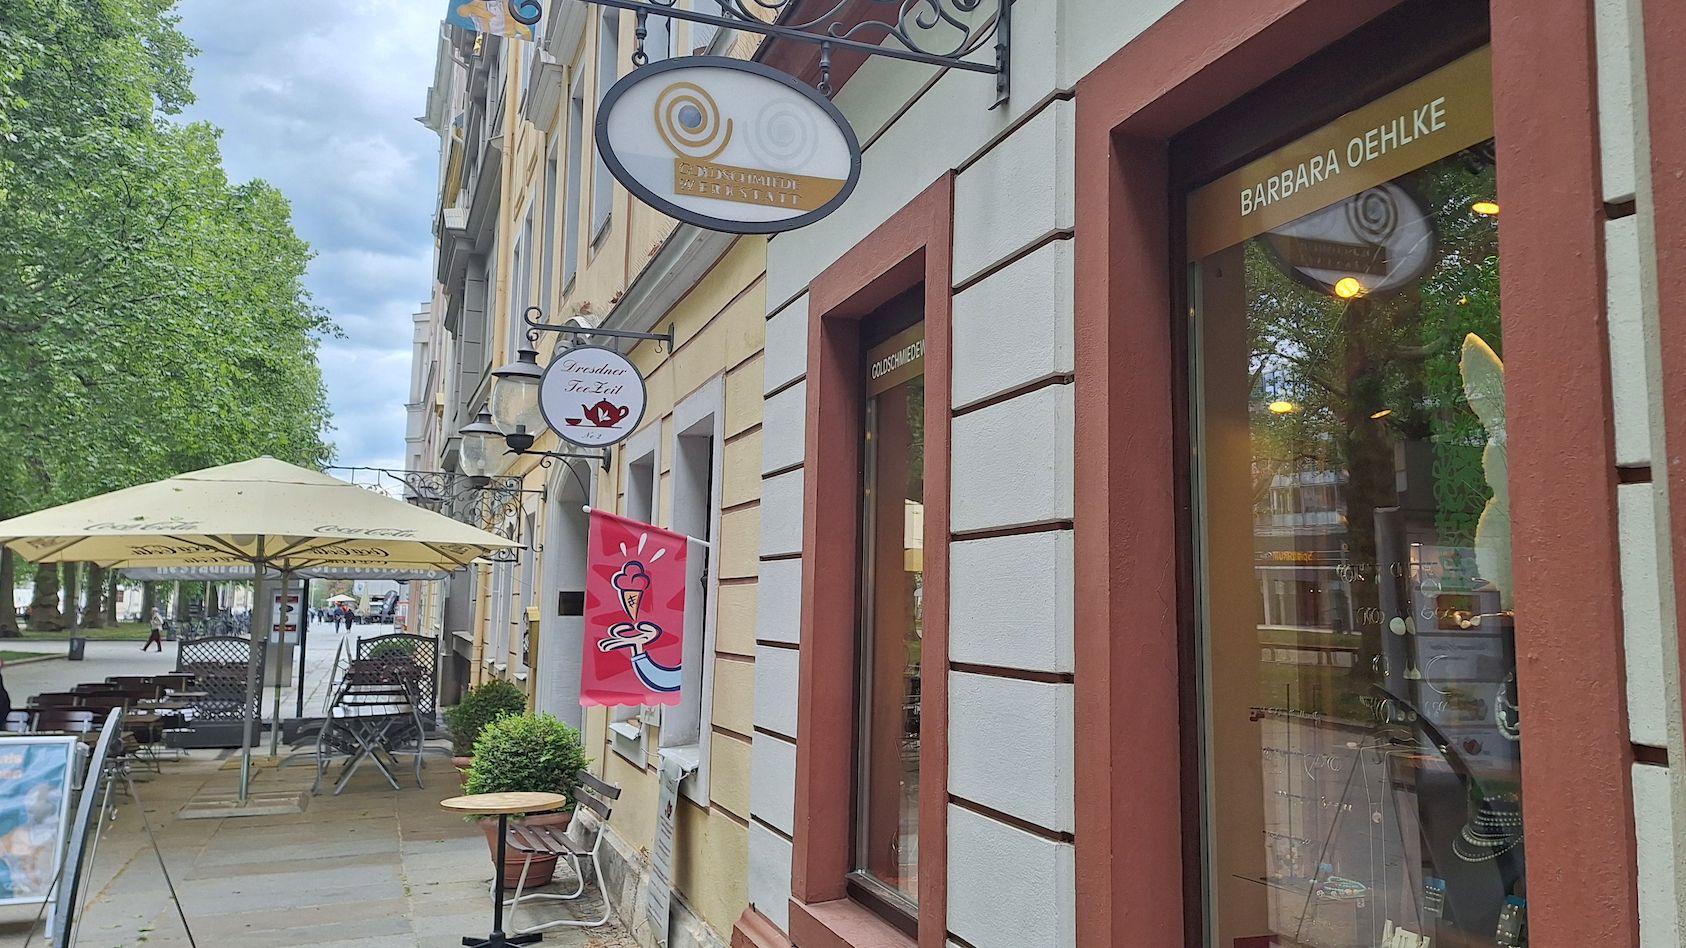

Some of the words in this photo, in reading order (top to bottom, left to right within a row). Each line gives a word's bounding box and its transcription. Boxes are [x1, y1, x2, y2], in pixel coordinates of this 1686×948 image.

[1240, 149, 1340, 217] BARBARA
[1346, 96, 1446, 168] OEHLKE
[561, 359, 627, 376] Dresdner
